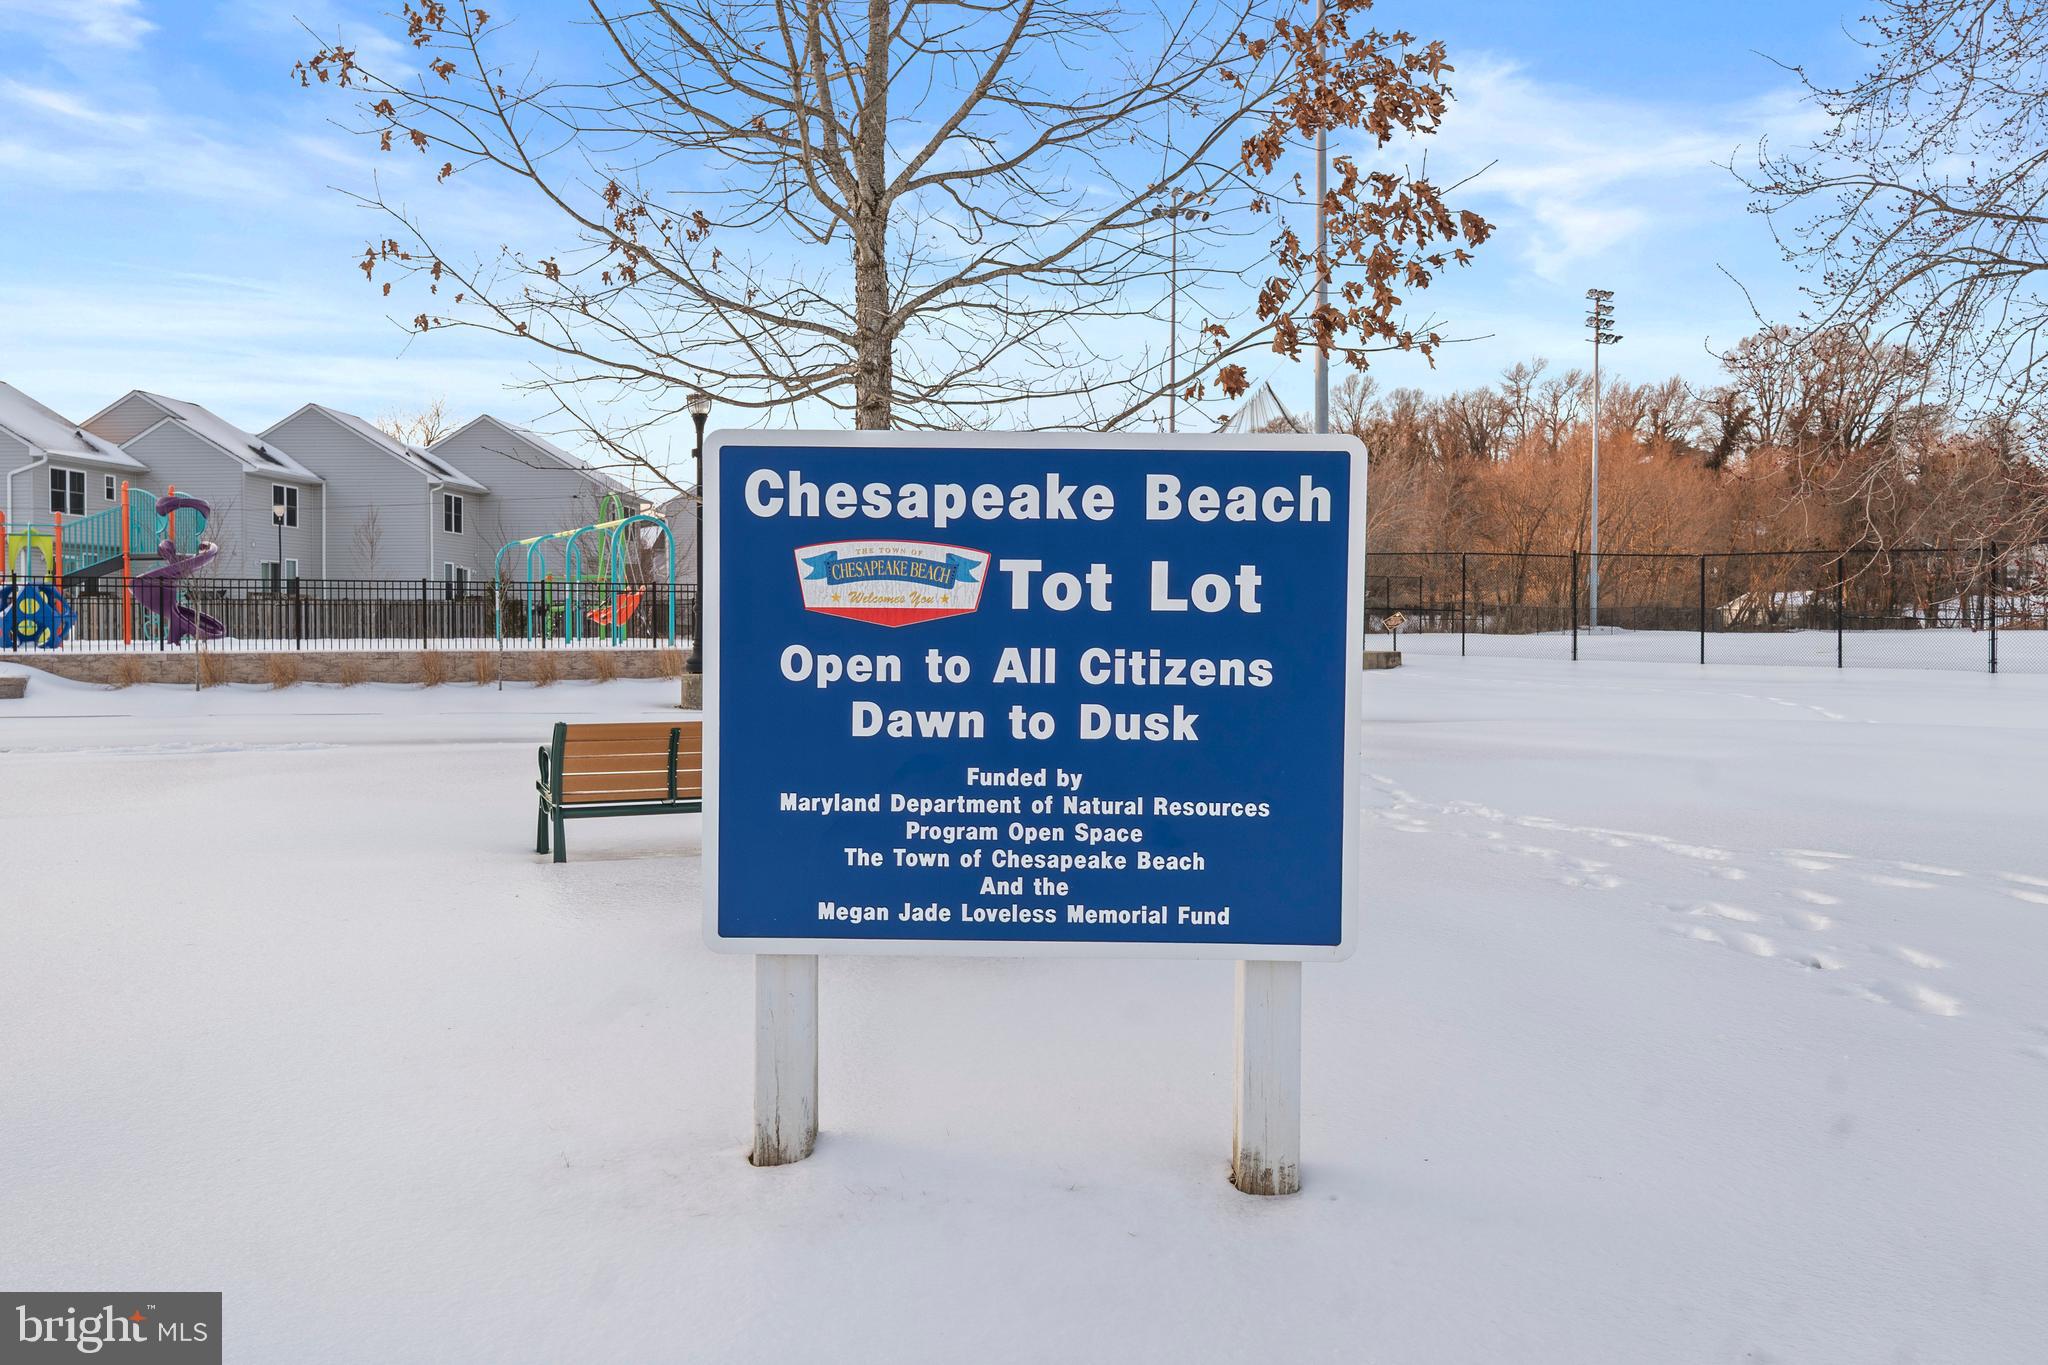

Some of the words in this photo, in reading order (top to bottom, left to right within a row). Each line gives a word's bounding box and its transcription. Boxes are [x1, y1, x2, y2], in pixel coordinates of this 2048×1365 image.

[745, 469, 1114, 528] Chesapeake
[1146, 474, 1330, 522] Beach
[879, 547, 906, 555] TOWN
[832, 560, 908, 580] CHESAPEAKE
[910, 560, 951, 584] BEACH
[1000, 560, 1112, 611] Tot
[1151, 561, 1261, 613] Lot
[848, 591, 905, 604] Welcomes
[909, 591, 935, 607] You
[781, 645, 900, 688] Open
[925, 649, 970, 683] to
[993, 648, 1055, 683] All
[1080, 648, 1272, 687] Citizens
[852, 701, 984, 737] Dawn
[1009, 706, 1055, 739] to
[1080, 704, 1199, 741] Dusk
[968, 768, 1046, 786] Funded
[1057, 769, 1082, 791] by
[781, 793, 880, 815] Maryland
[891, 794, 1020, 816] Department
[1032, 796, 1053, 813] of
[1064, 796, 1142, 815] Natural
[1154, 797, 1269, 817] Resources
[907, 822, 997, 843] Program
[1009, 822, 1064, 844] Open
[1075, 823, 1142, 845] Space
[844, 848, 883, 866] The
[893, 849, 949, 867] Town
[960, 849, 981, 867] of
[992, 849, 1126, 872] Chesapeake
[1138, 852, 1204, 870] Beach
[980, 877, 1022, 895] And
[1034, 877, 1068, 896] the
[819, 902, 888, 923] Megan
[899, 903, 951, 922] Jade
[962, 904, 1056, 923] Loveless
[1068, 905, 1167, 924] Memorial
[1179, 907, 1229, 925] Fund
